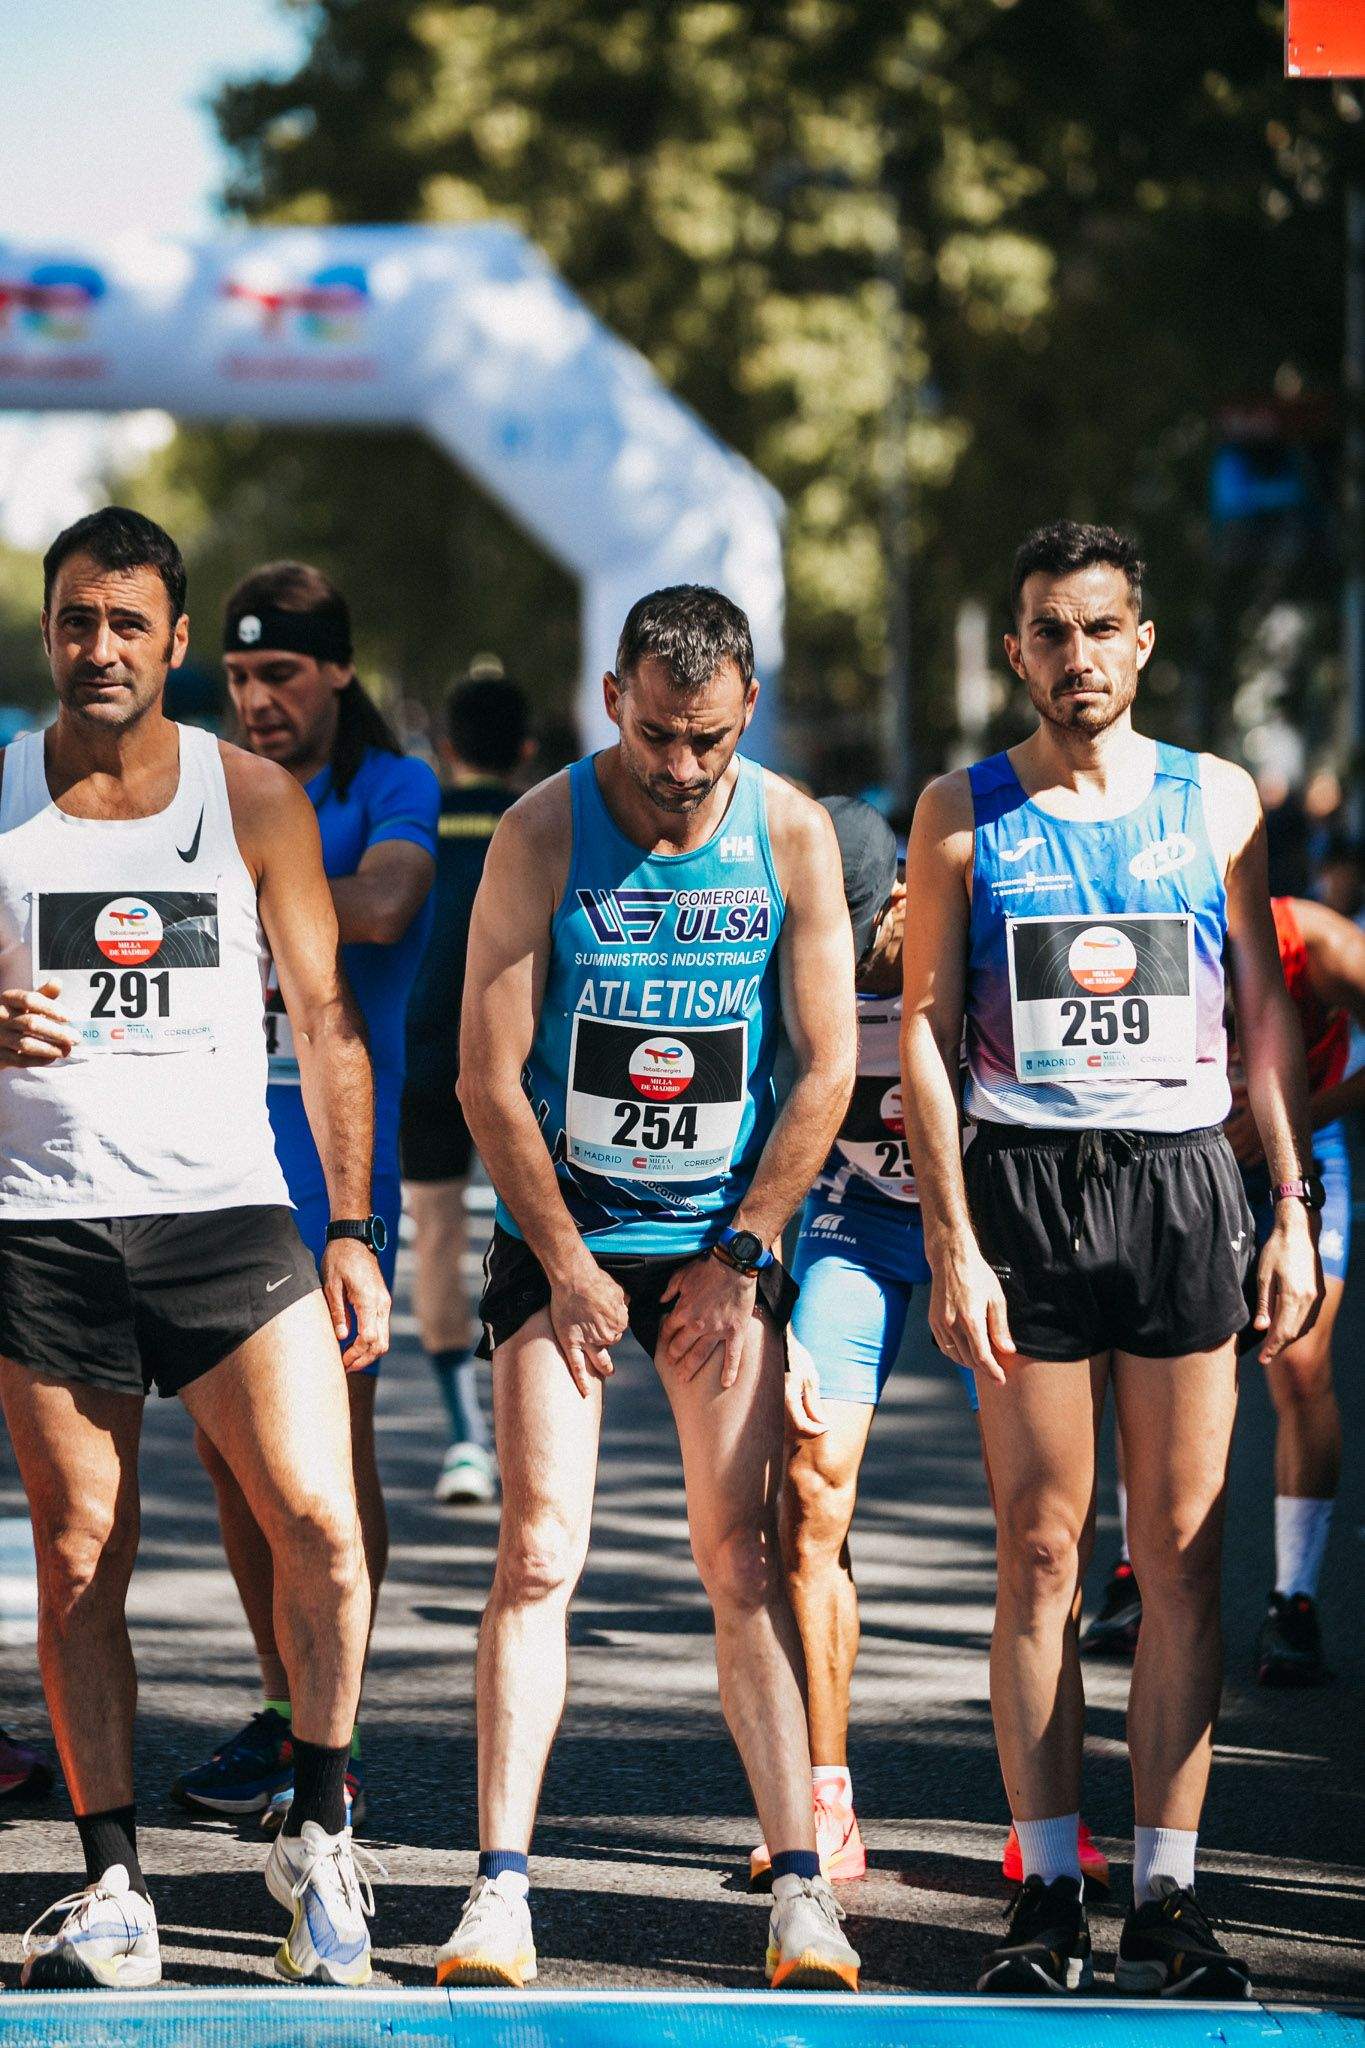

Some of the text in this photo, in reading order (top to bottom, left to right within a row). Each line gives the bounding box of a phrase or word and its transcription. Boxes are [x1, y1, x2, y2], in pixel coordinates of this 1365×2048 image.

[676, 888, 769, 906] COMERCIAL
[675, 907, 770, 943] ULSA
[575, 949, 767, 967] SUMINISTROS INDUSTRIALES
[89, 971, 170, 1019] 291
[575, 975, 760, 1019] ATLETISMO
[1060, 998, 1150, 1047] 259
[1037, 1058, 1076, 1068] MADRID
[611, 1102, 698, 1150] 254
[584, 1150, 622, 1164] MADRID
